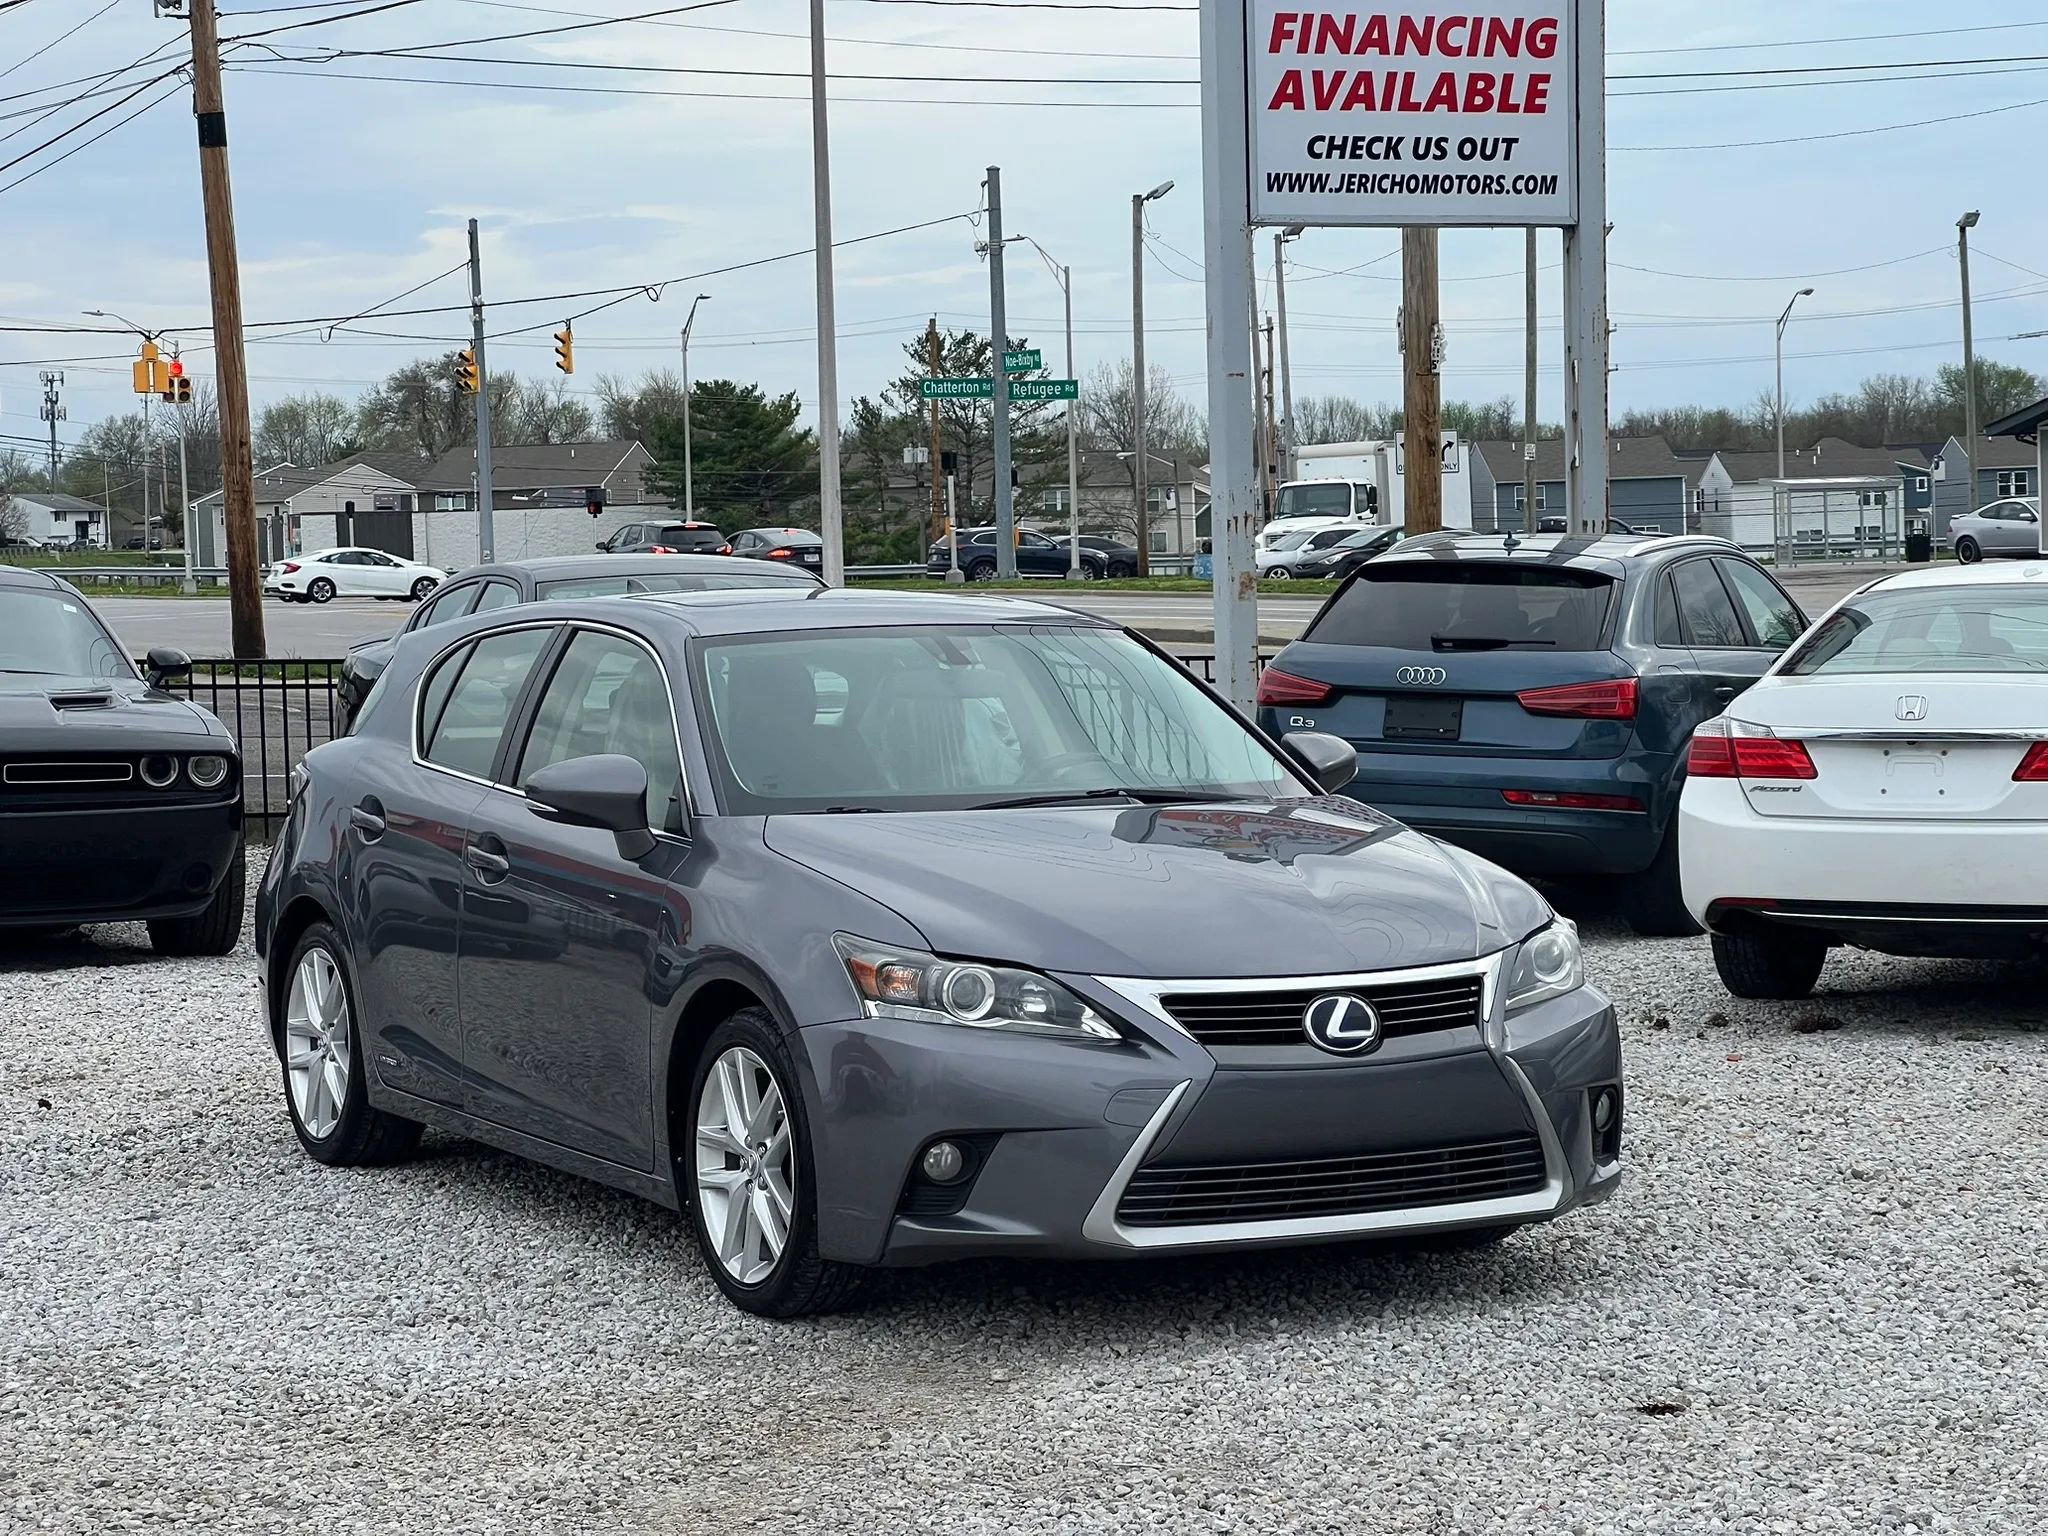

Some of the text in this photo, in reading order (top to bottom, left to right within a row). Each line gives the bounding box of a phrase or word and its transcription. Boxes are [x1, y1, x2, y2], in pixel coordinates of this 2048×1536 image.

[1268, 13, 1559, 59] FINANCING
[1267, 70, 1552, 114] AVAILABLE
[1307, 135, 1520, 162] CHECK US OUT
[1266, 172, 1559, 196] WWW.JERICHOMOTORS.COM
[923, 381, 991, 394] Chatterton Rd
[1012, 383, 1075, 399] Refugee Rd
[1290, 716, 1315, 728] Q3
